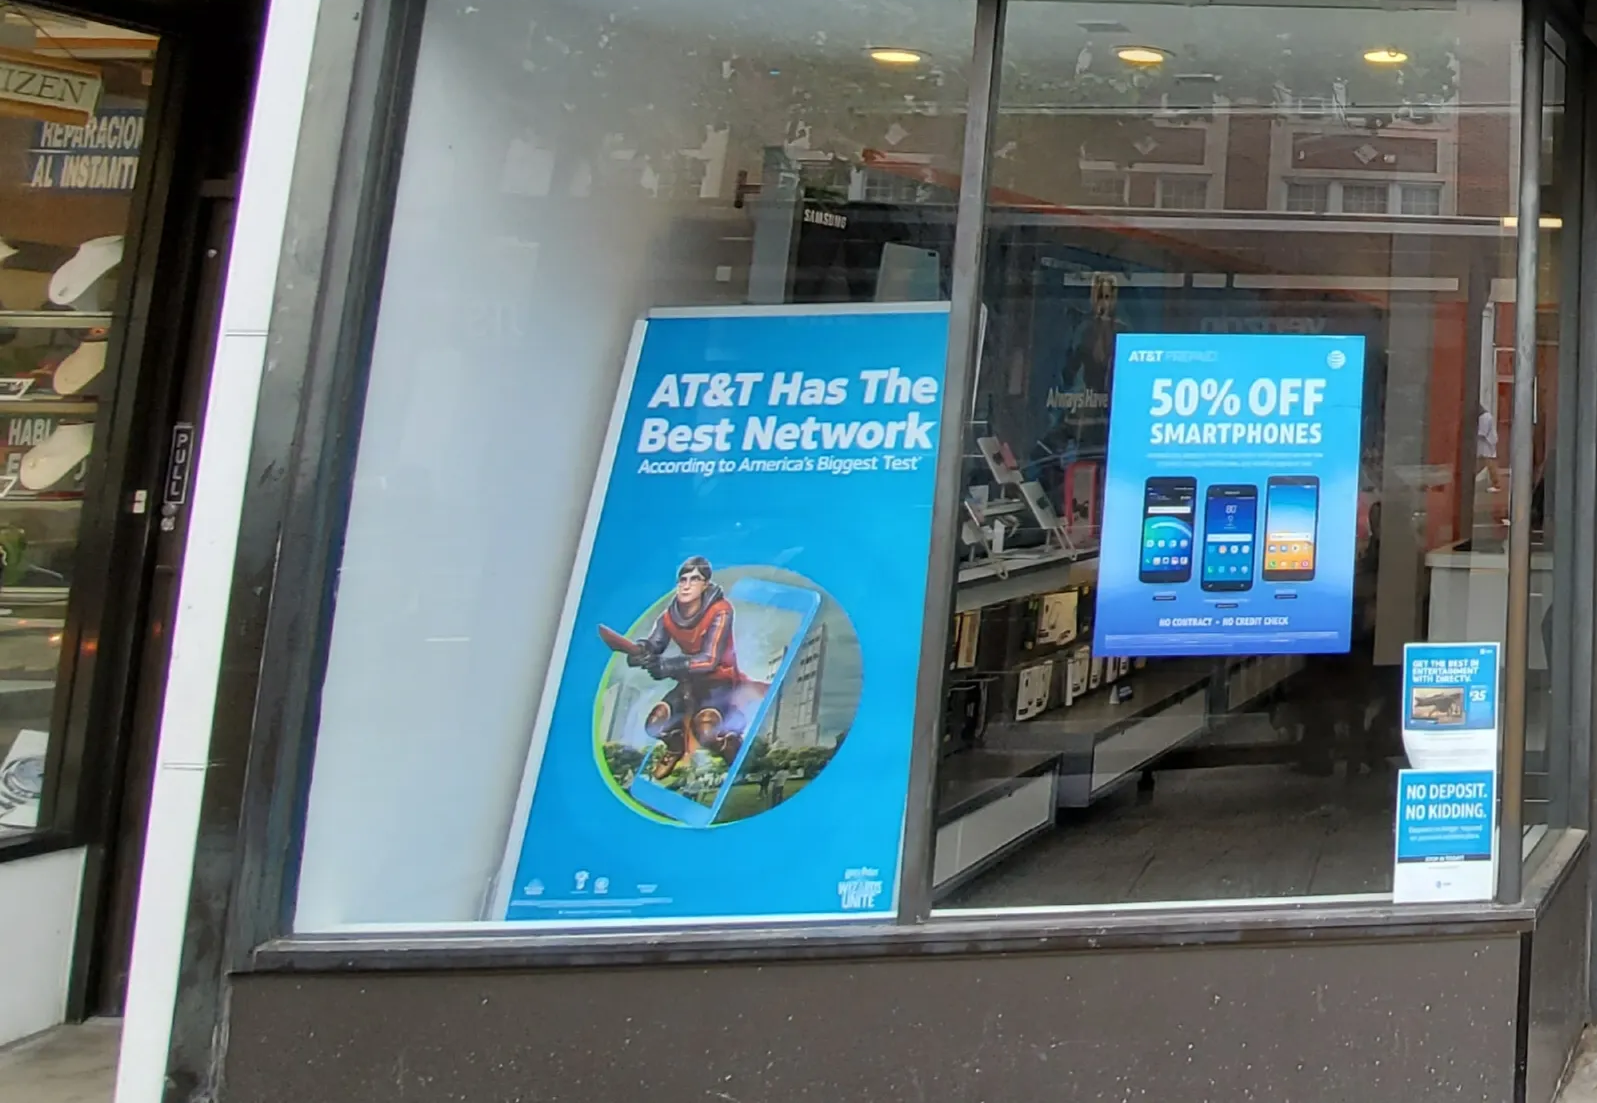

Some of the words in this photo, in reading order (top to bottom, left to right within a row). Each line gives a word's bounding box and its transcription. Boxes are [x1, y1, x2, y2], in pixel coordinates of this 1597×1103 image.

[0, 66, 88, 104] IZEN
[30, 155, 53, 188] AL
[803, 209, 848, 229] SAMSUNG
[1128, 351, 1163, 362] AT&T
[648, 372, 764, 408] AT&T
[768, 371, 848, 406] Has
[860, 367, 938, 404] The
[1149, 378, 1241, 417] 50%
[1248, 378, 1327, 416] OFF
[637, 416, 735, 454] Best
[741, 411, 938, 452] Network
[1149, 422, 1323, 445] SMARTPHONES
[170, 432, 190, 498] PULL
[638, 458, 715, 478] According
[718, 458, 736, 474] to
[738, 456, 814, 473] America's
[817, 455, 878, 475] Biggest
[1158, 617, 1171, 627] NO
[1222, 617, 1235, 626] NO
[1406, 784, 1427, 800] NO
[1428, 783, 1488, 799] DEPOSIT.
[1405, 805, 1426, 821] NO
[1427, 803, 1487, 819] KIDDING.
